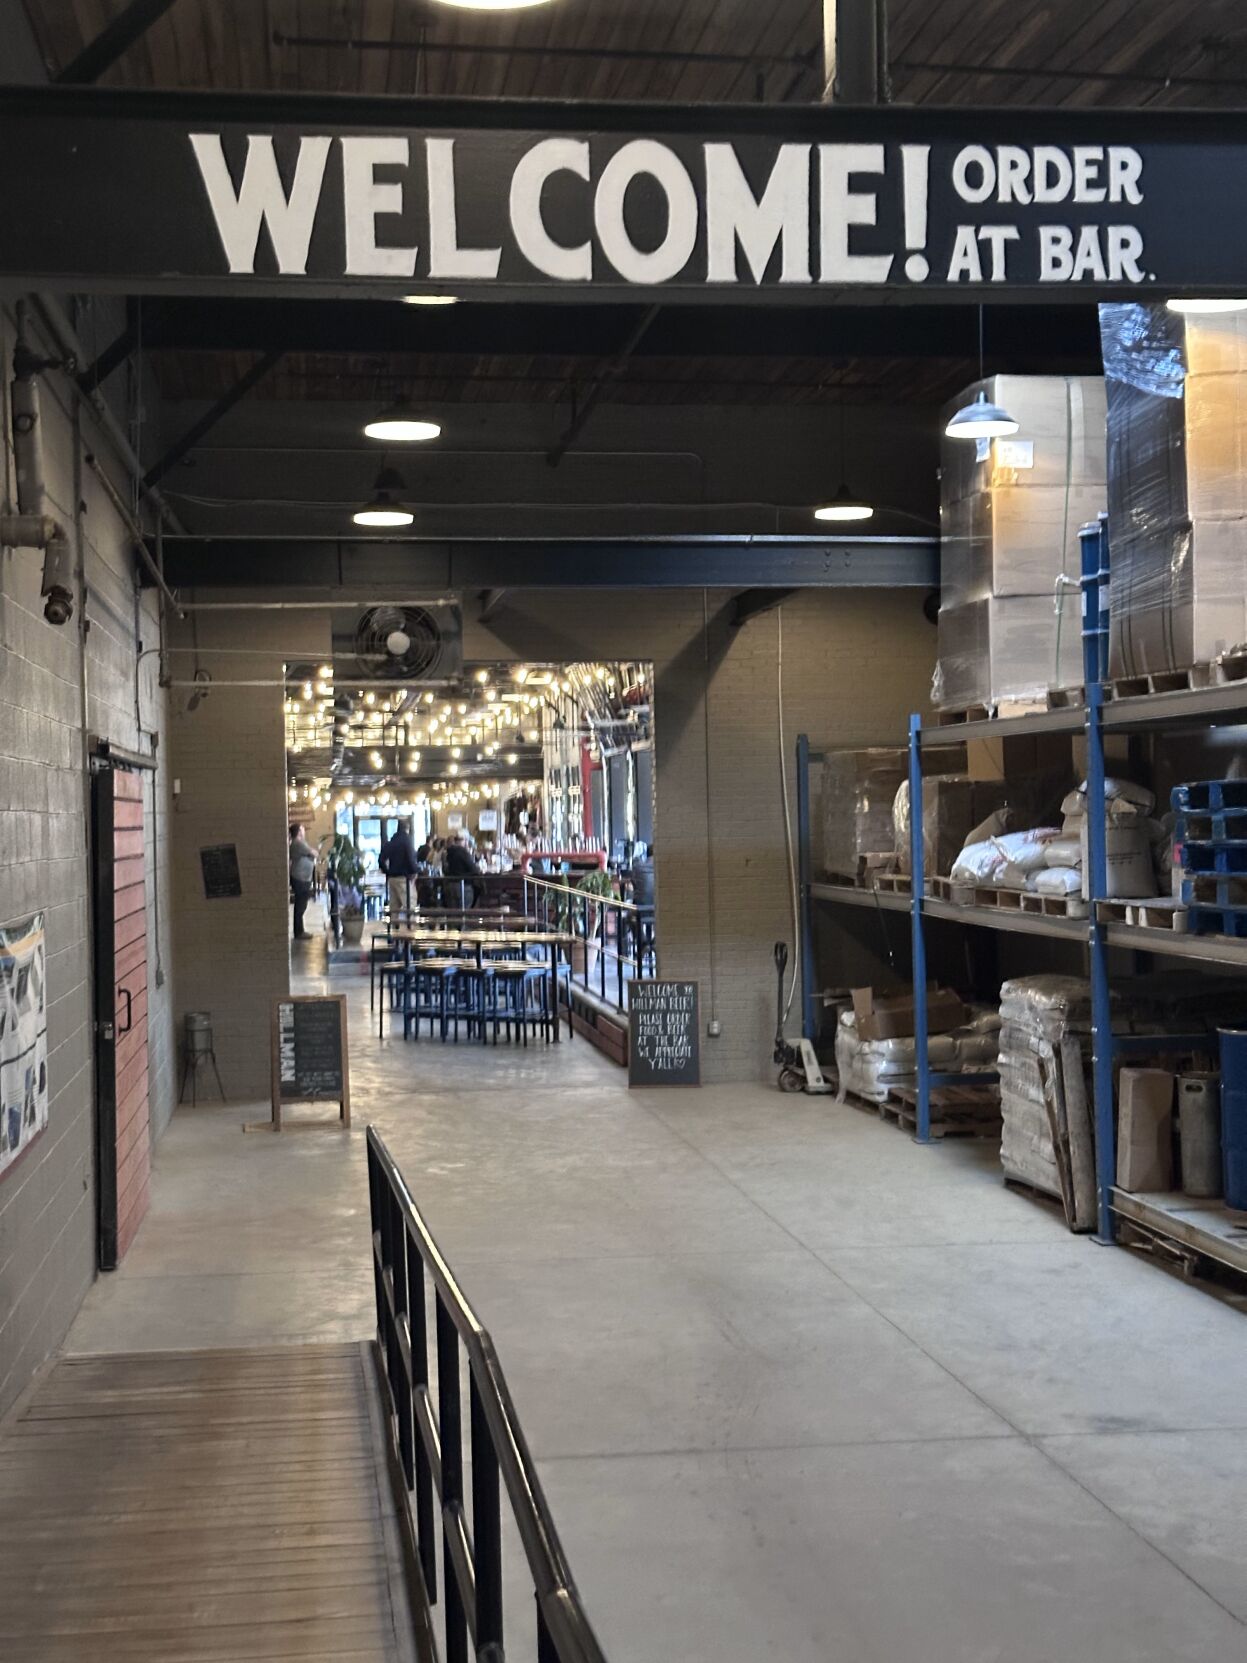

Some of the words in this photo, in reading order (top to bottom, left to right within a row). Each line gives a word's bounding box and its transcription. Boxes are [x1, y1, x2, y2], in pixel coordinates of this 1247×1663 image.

[951, 144, 1144, 205] ORDER
[188, 133, 931, 286] WELCOME!
[946, 225, 1020, 282] AT
[1038, 225, 1157, 283] BAR.
[638, 984, 678, 997] WELCOME
[632, 997, 666, 1010] HILLMAN
[639, 1013, 662, 1025] PLEASE
[638, 1035, 648, 1046] AT
[655, 1035, 668, 1046] THE
